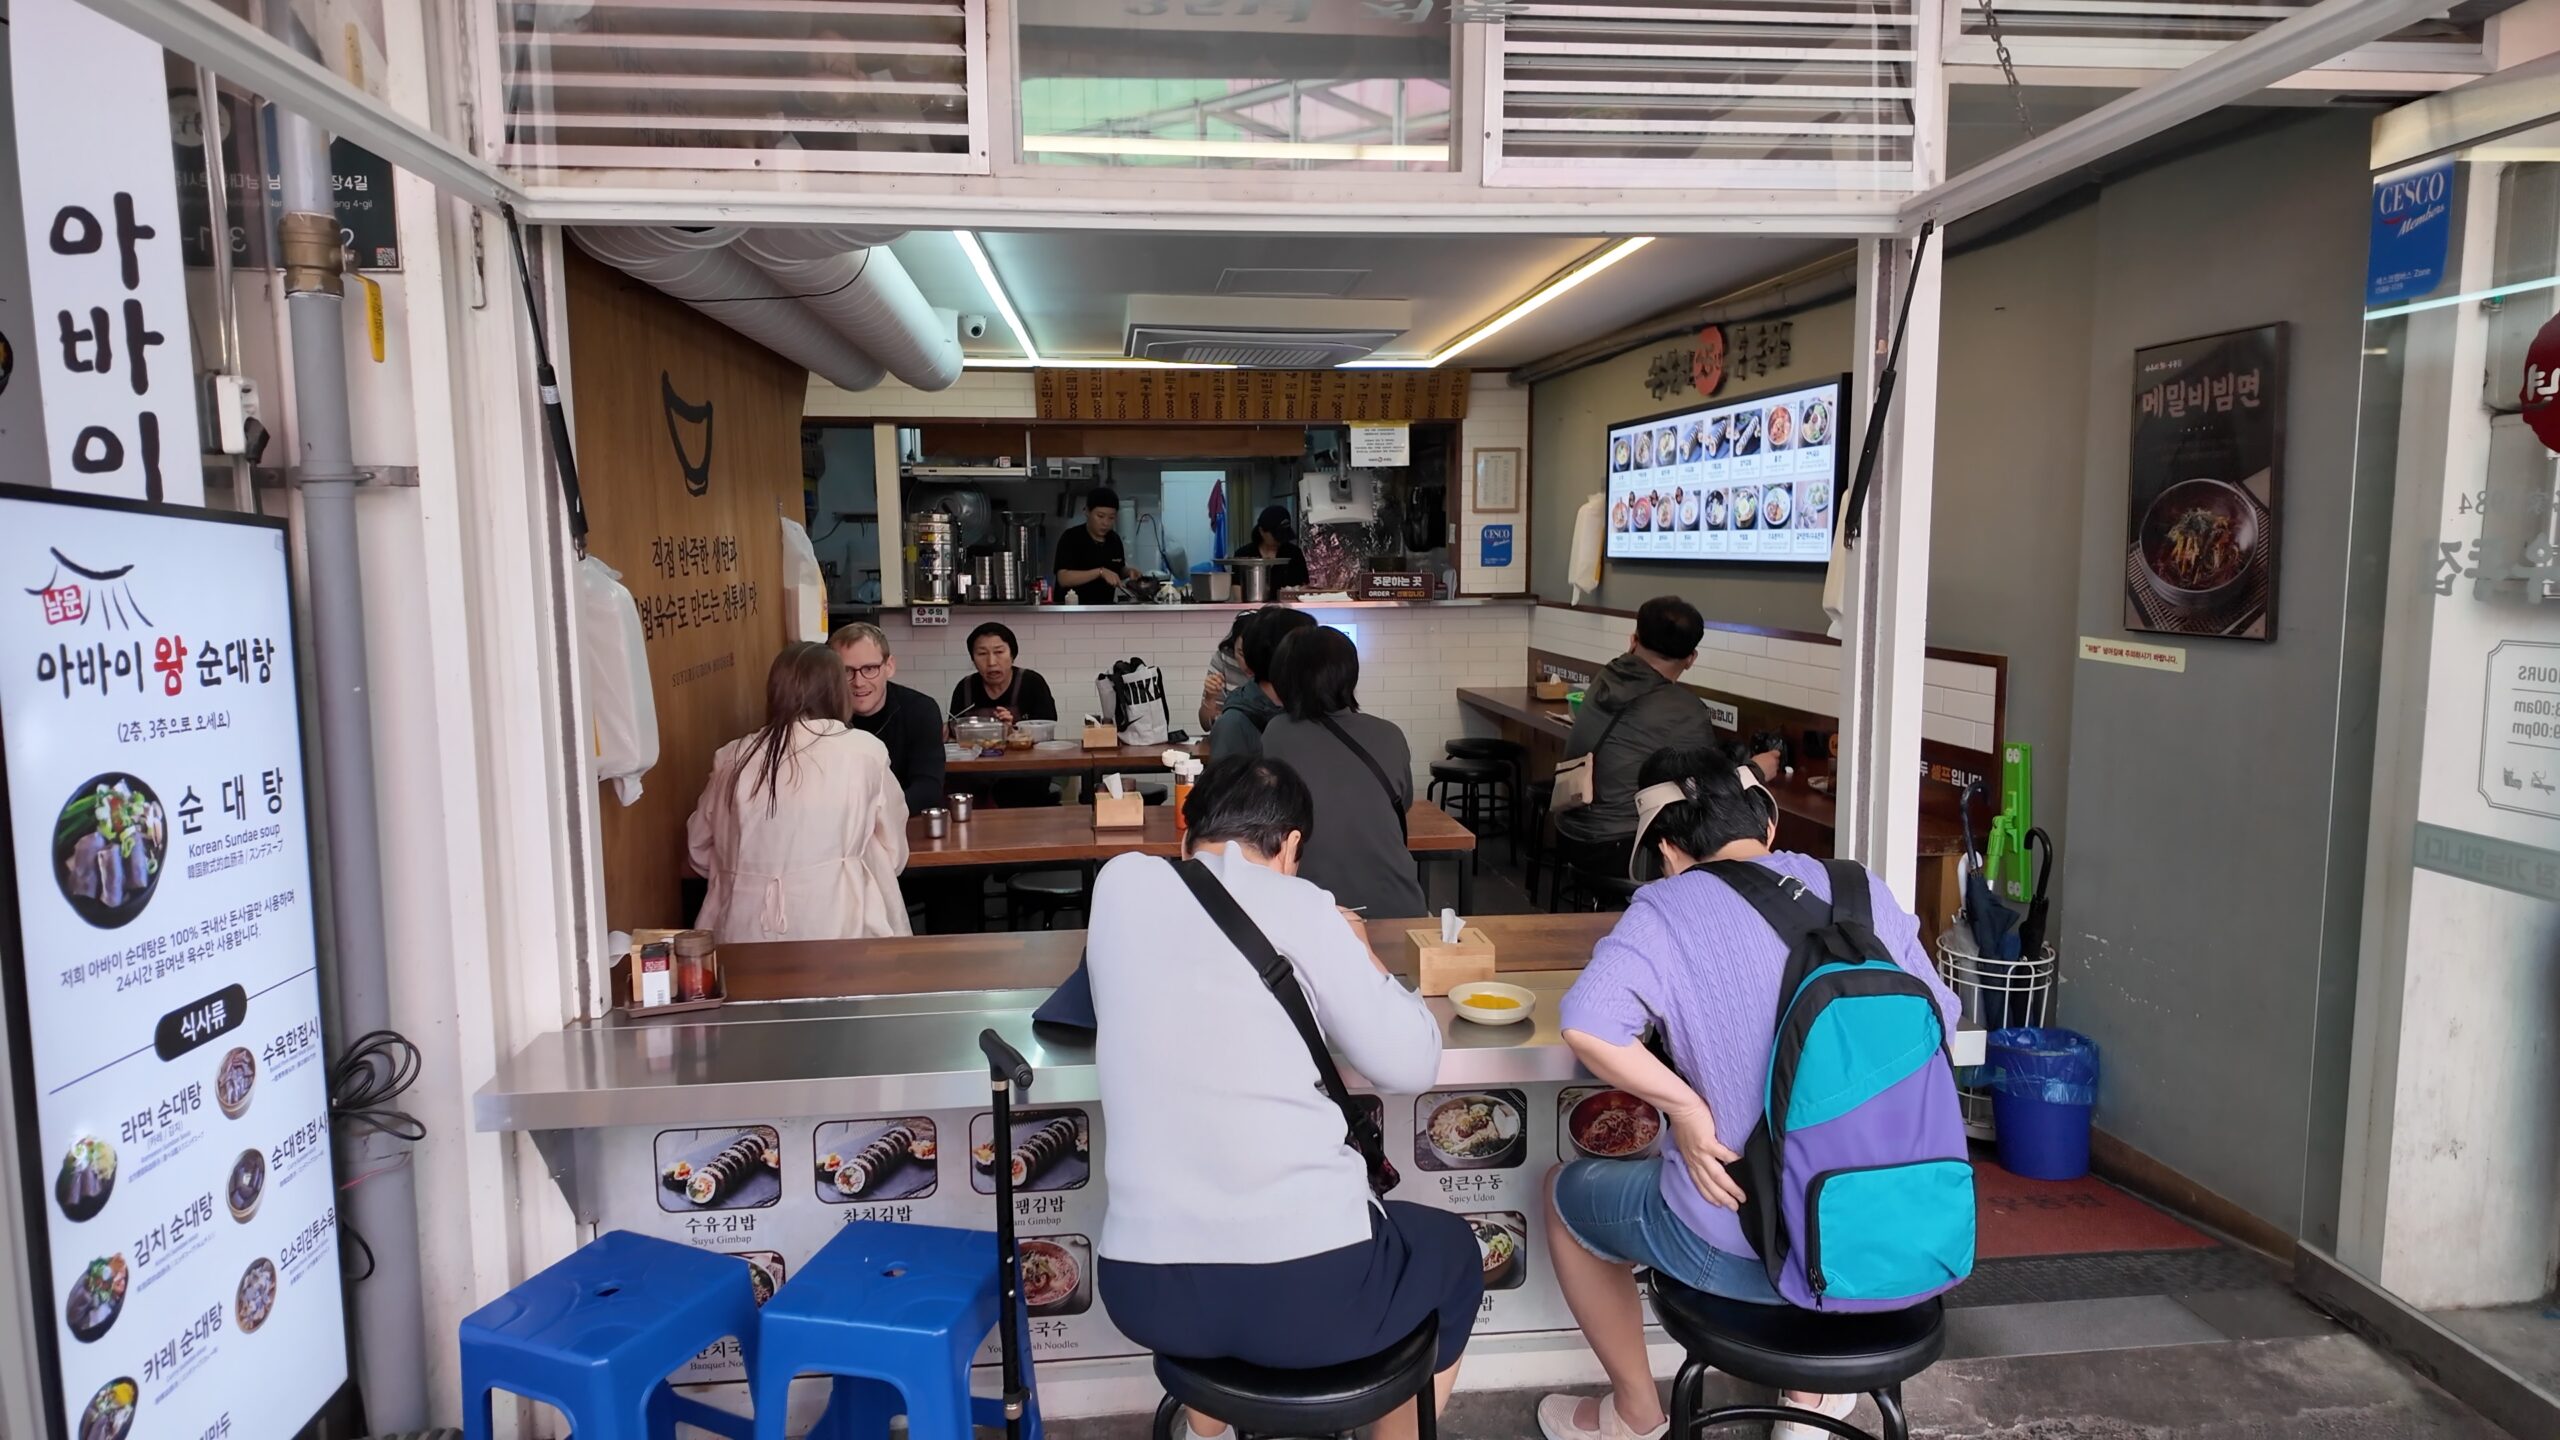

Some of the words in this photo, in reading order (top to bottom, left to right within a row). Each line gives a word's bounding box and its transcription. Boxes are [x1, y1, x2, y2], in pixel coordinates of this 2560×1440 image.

[268, 174, 367, 191] 남장4길
[2379, 172, 2444, 215] CESCO
[2398, 203, 2446, 238] Members
[50, 192, 164, 501] 아바이
[2142, 368, 2260, 418] 메밀비빔면
[1484, 529, 1510, 539] CESCO
[652, 536, 675, 580] 직접
[678, 536, 709, 577] 반죽한
[712, 536, 737, 573] 생면과
[1412, 576, 1422, 587] 곳
[690, 589, 720, 628] 만드는
[38, 641, 144, 698] 아바이
[153, 635, 188, 696] 왕
[196, 637, 275, 687] 순대탕
[117, 720, 146, 743] (2층,
[149, 715, 192, 739] 3층으로
[196, 711, 231, 731] 오세요)
[188, 839, 223, 858] Korean
[225, 829, 258, 848] Sundae
[260, 824, 280, 839] soup
[61, 965, 85, 988] 저희
[88, 952, 122, 978] 아바이
[125, 936, 167, 966] 순대탕은
[170, 926, 198, 948] 100%
[200, 916, 227, 936] 국내산
[229, 902, 262, 925] 돈사골만
[117, 967, 152, 992] 24시간
[187, 940, 214, 963] 육수만
[217, 923, 261, 952] 사용합니다.
[180, 1000, 227, 1042] 식사류
[121, 1106, 154, 1144] 라면
[157, 1081, 202, 1128] 순대탕
[1439, 1174, 1503, 1192] 얼큰우동
[1448, 1194, 1470, 1204] Spicy
[1473, 1193, 1495, 1202] Udon
[1015, 1196, 1065, 1215] 팸김밥
[1028, 1217, 1061, 1226] Gimbap
[134, 1230, 167, 1268] 김치
[170, 1192, 213, 1242] 순대탕
[685, 1214, 757, 1234] 수유김밥
[691, 1237, 714, 1247] Suyu
[716, 1234, 752, 1245] Gimbap
[143, 1338, 177, 1383] 카레
[180, 1302, 223, 1357] 순대탕
[696, 1341, 743, 1359] 치국
[1045, 1341, 1078, 1350] Noodles
[690, 1361, 725, 1370] Banquet
